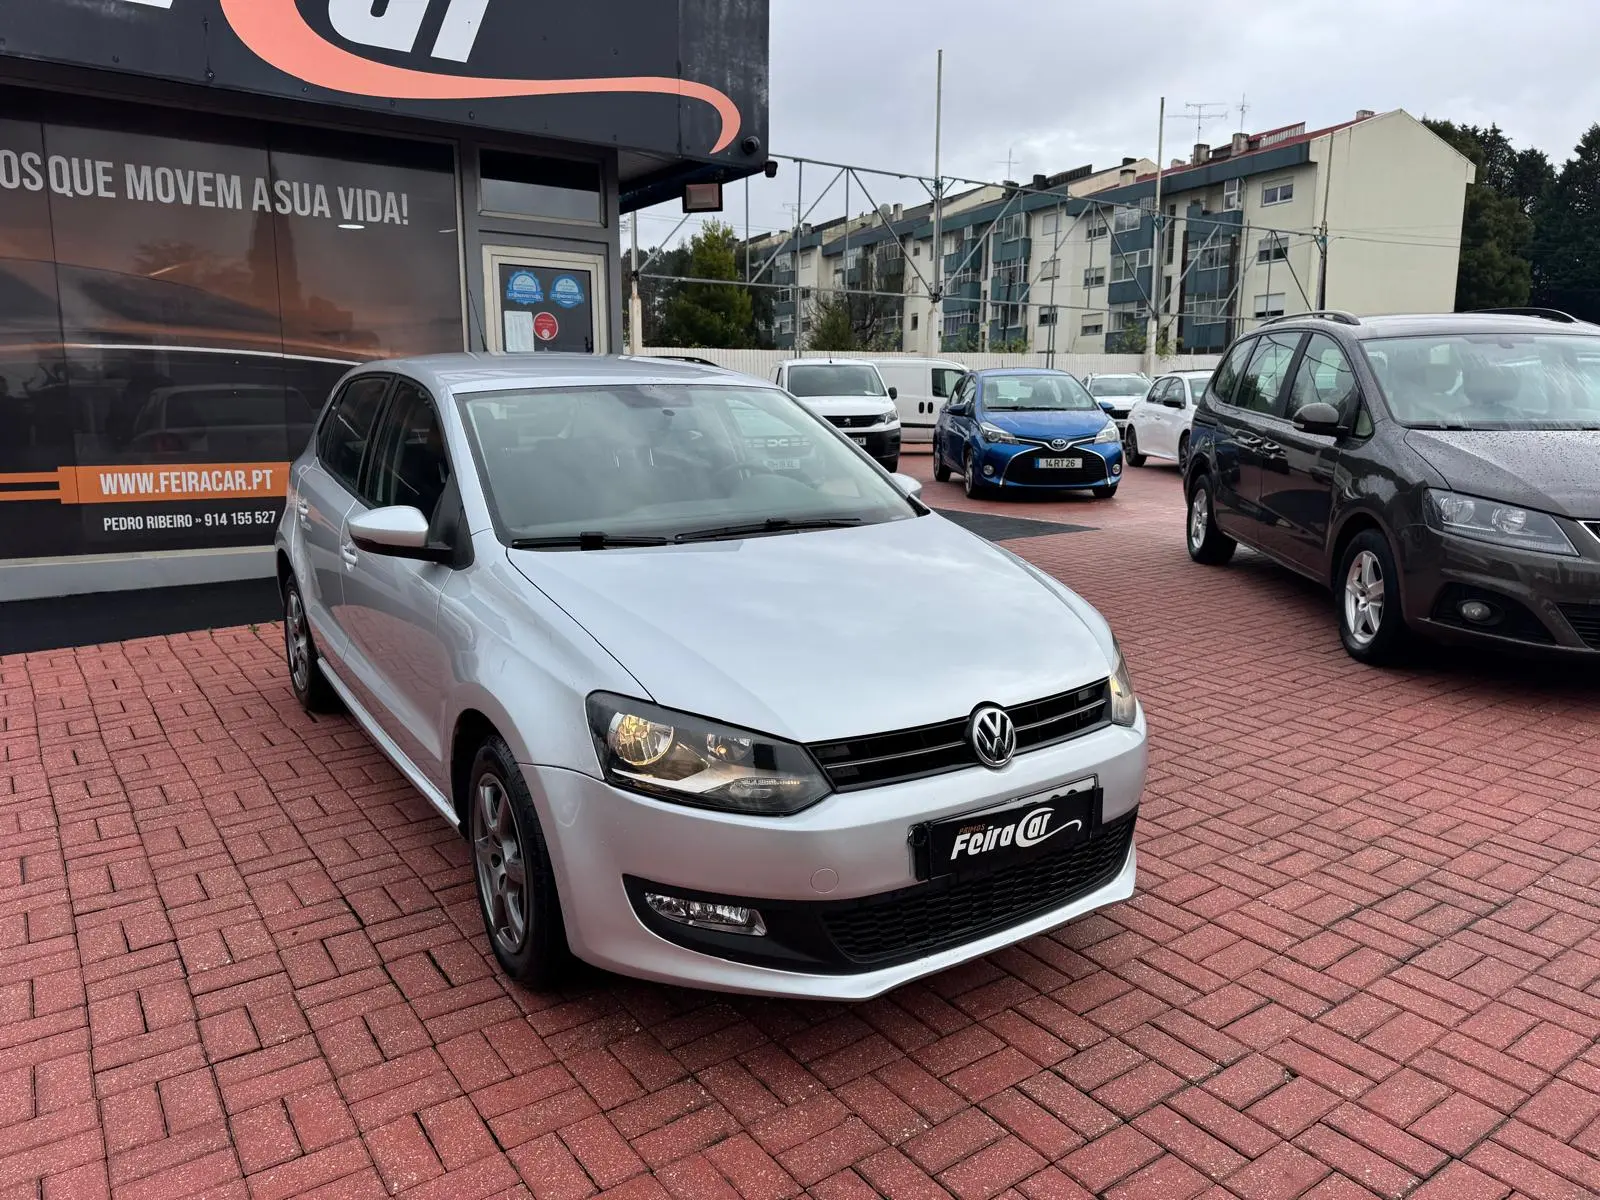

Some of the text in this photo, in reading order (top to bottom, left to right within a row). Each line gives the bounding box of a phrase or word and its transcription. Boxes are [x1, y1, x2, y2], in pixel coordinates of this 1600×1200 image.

[48, 155, 116, 198] QUE
[124, 163, 243, 210] MOVEM
[252, 178, 272, 213] A
[275, 179, 331, 219] SUA
[337, 186, 409, 226] VIDA!
[100, 469, 273, 495] WWW.FEIRACAR.PT
[103, 516, 144, 532] PEDRO
[146, 514, 193, 530] RIBEIRO
[204, 512, 228, 527] 914
[231, 511, 253, 526] 155
[255, 510, 277, 525] 527
